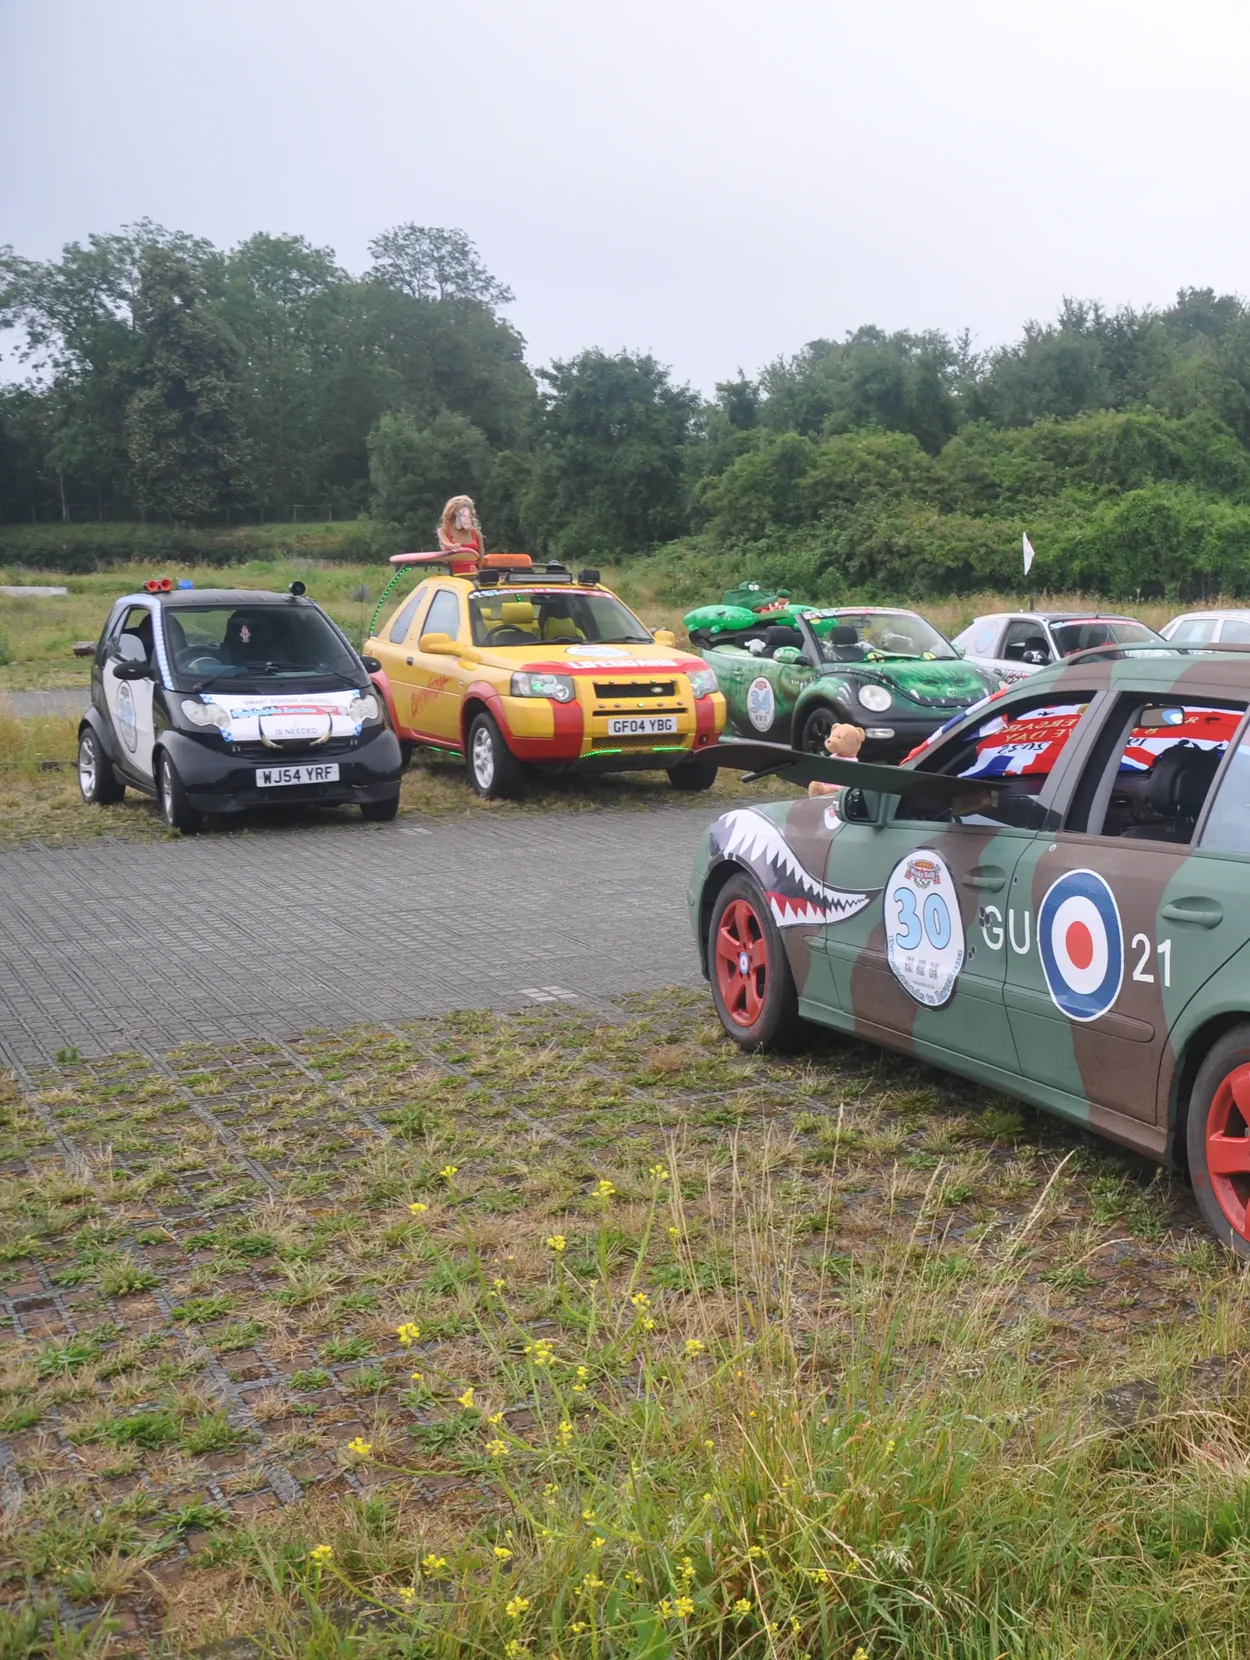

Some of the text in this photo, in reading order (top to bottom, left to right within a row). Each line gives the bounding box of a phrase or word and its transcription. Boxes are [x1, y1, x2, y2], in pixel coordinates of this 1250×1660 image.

[567, 659, 678, 670] LIFEGUARD
[750, 690, 771, 714] 34
[613, 718, 673, 733] GF04 YBG
[262, 766, 333, 784] WJ54 YRF
[893, 887, 952, 950] 30
[982, 905, 1031, 955] GU
[1131, 933, 1172, 987] 21
